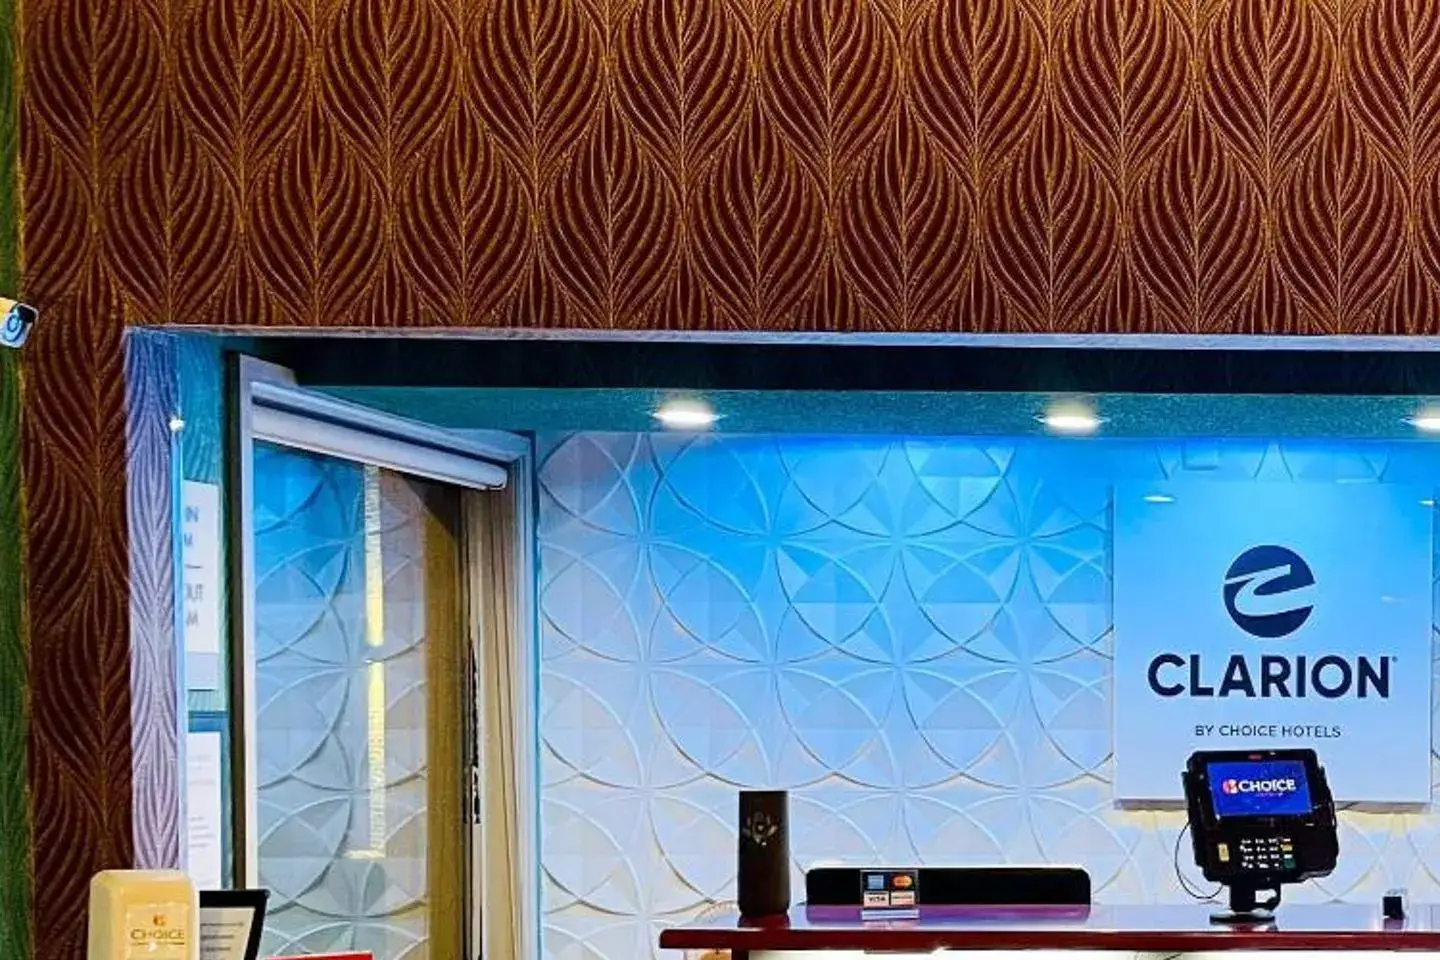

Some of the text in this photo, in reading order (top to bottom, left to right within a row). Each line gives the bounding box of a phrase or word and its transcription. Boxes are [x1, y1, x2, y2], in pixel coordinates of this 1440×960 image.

[1147, 653, 1390, 699] CLARION
[1195, 724, 1341, 738] BY CHOICE HOTELS
[1238, 779, 1297, 793] CHOICE
[130, 928, 185, 941] CHOICE
